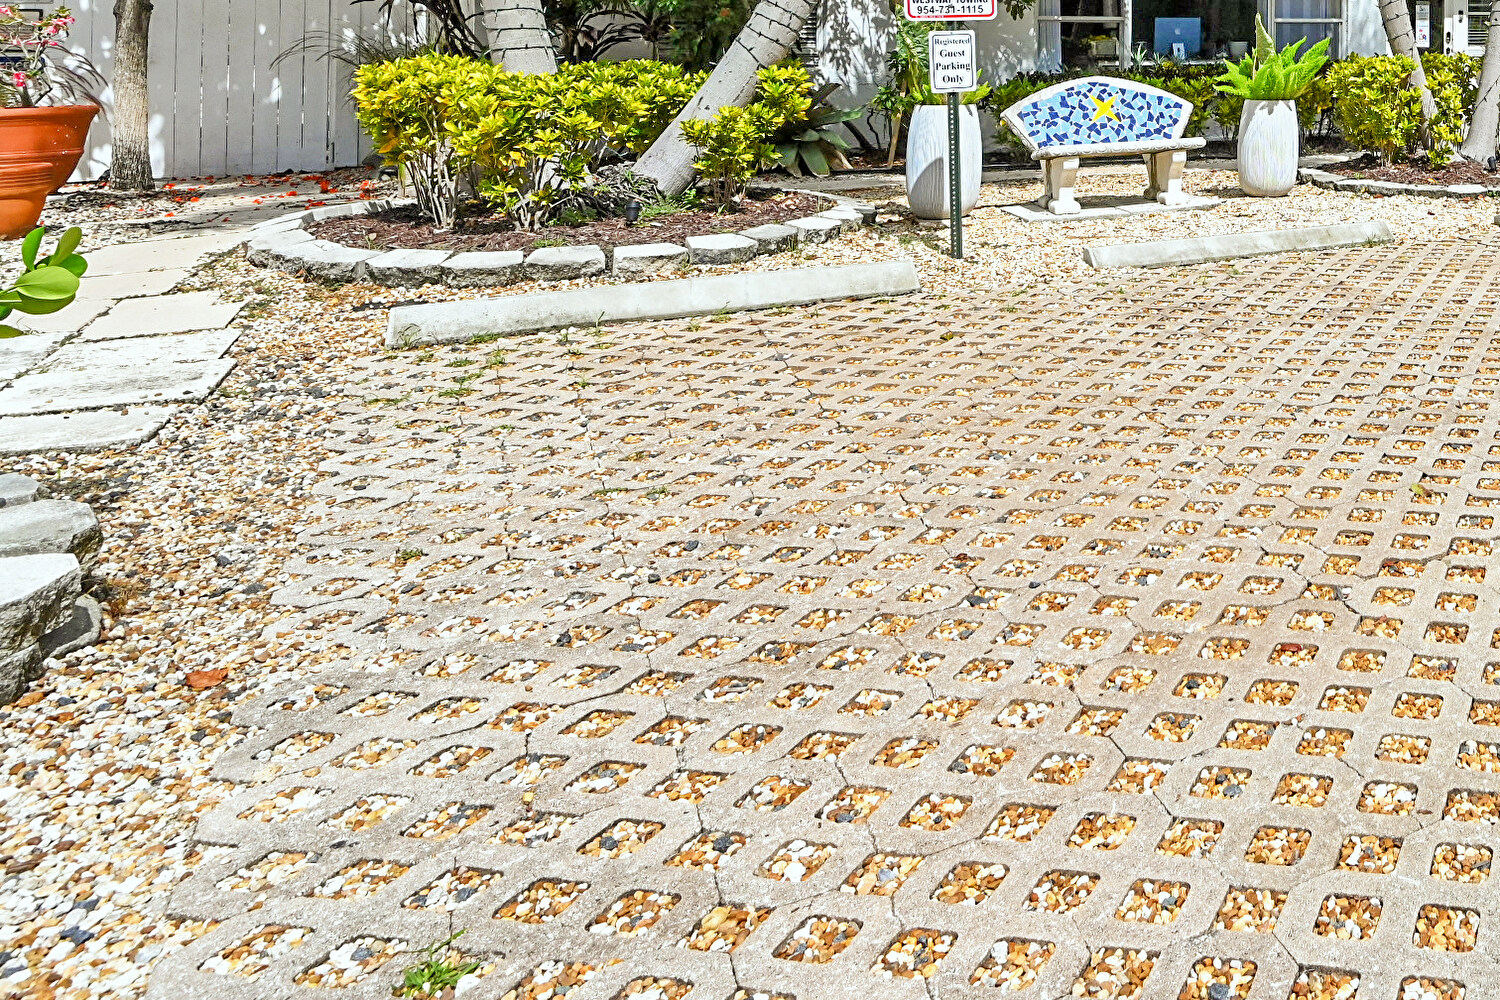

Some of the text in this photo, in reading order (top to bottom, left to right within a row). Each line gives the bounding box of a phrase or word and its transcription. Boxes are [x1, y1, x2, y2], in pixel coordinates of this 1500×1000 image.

[917, 5, 984, 14] 954-731-1115
[940, 49, 965, 58] Guest
[936, 62, 970, 72] Parking
[942, 75, 964, 84] Only
